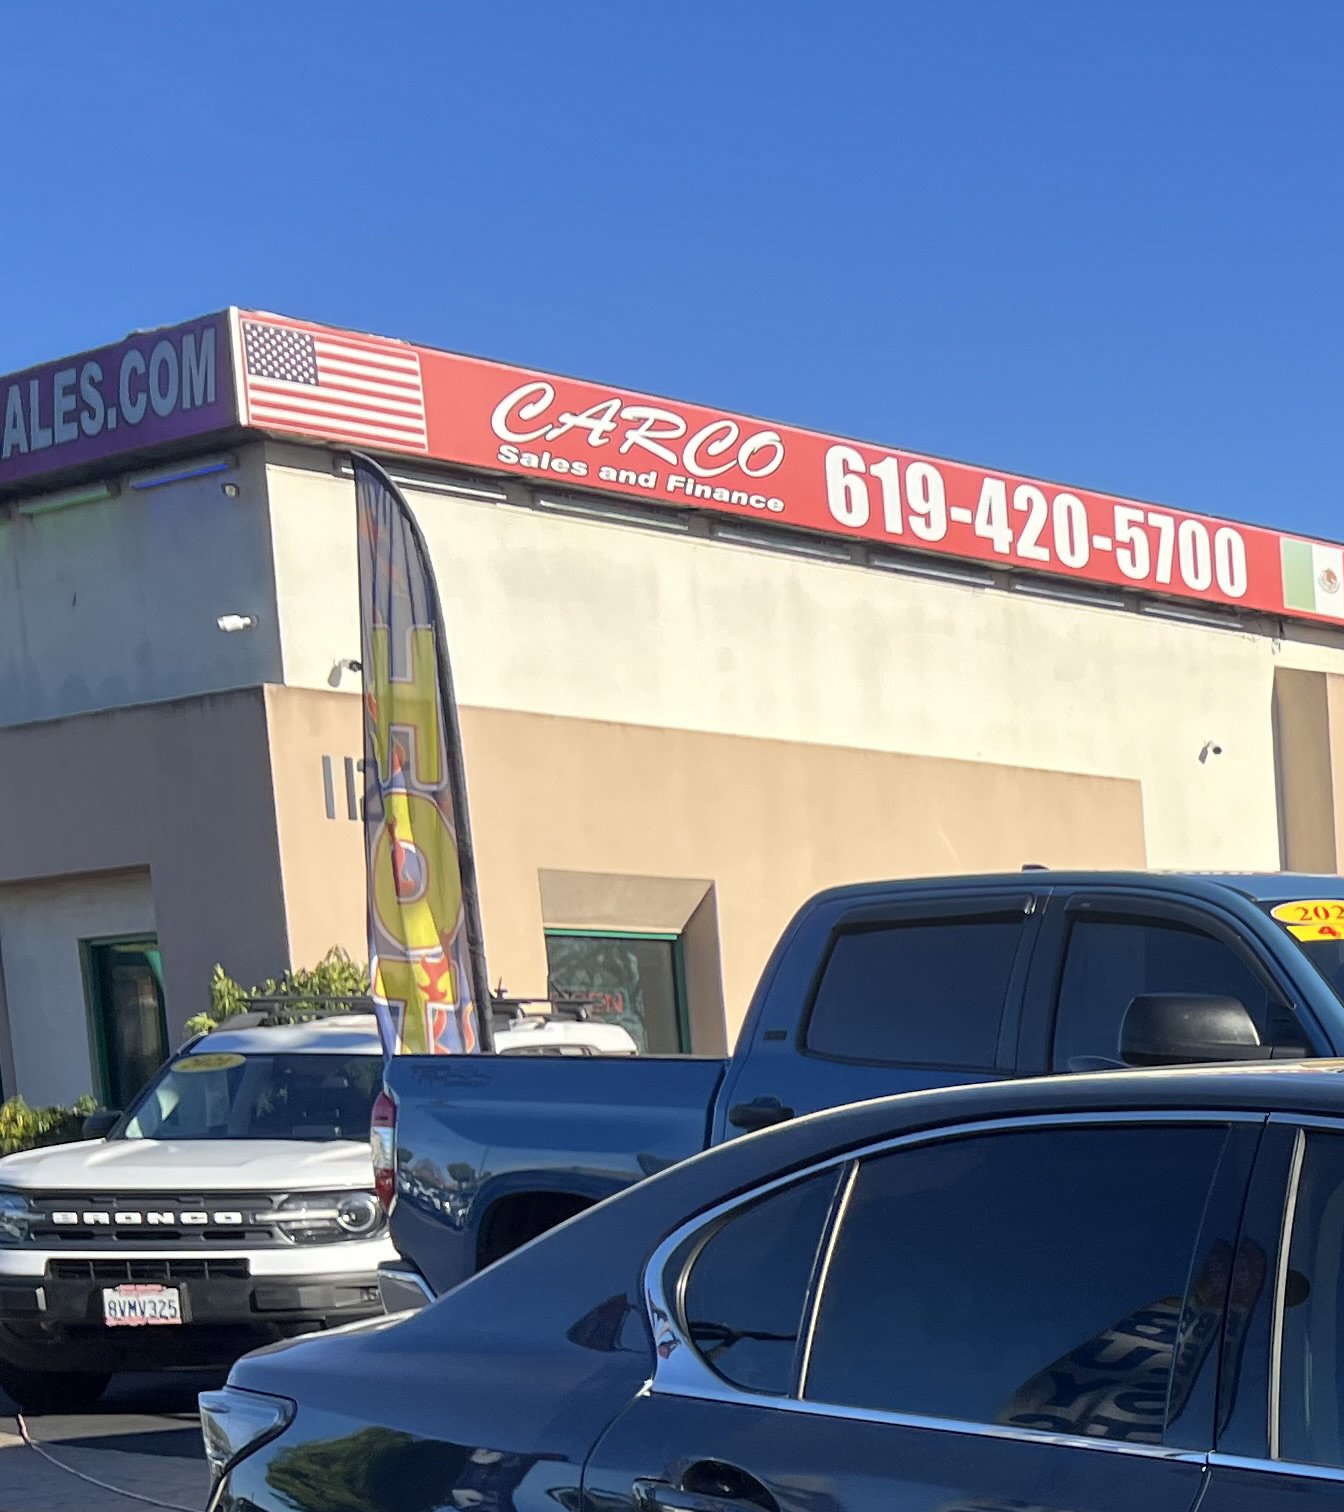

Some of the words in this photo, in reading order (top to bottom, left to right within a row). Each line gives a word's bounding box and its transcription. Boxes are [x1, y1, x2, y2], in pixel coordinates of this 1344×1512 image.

[491, 382, 785, 477] CARCO
[497, 444, 589, 476] Sales
[598, 465, 658, 489] and
[666, 474, 785, 512] Finance
[824, 444, 1248, 598] 619-420-5700
[52, 1211, 243, 1225] BRONCO
